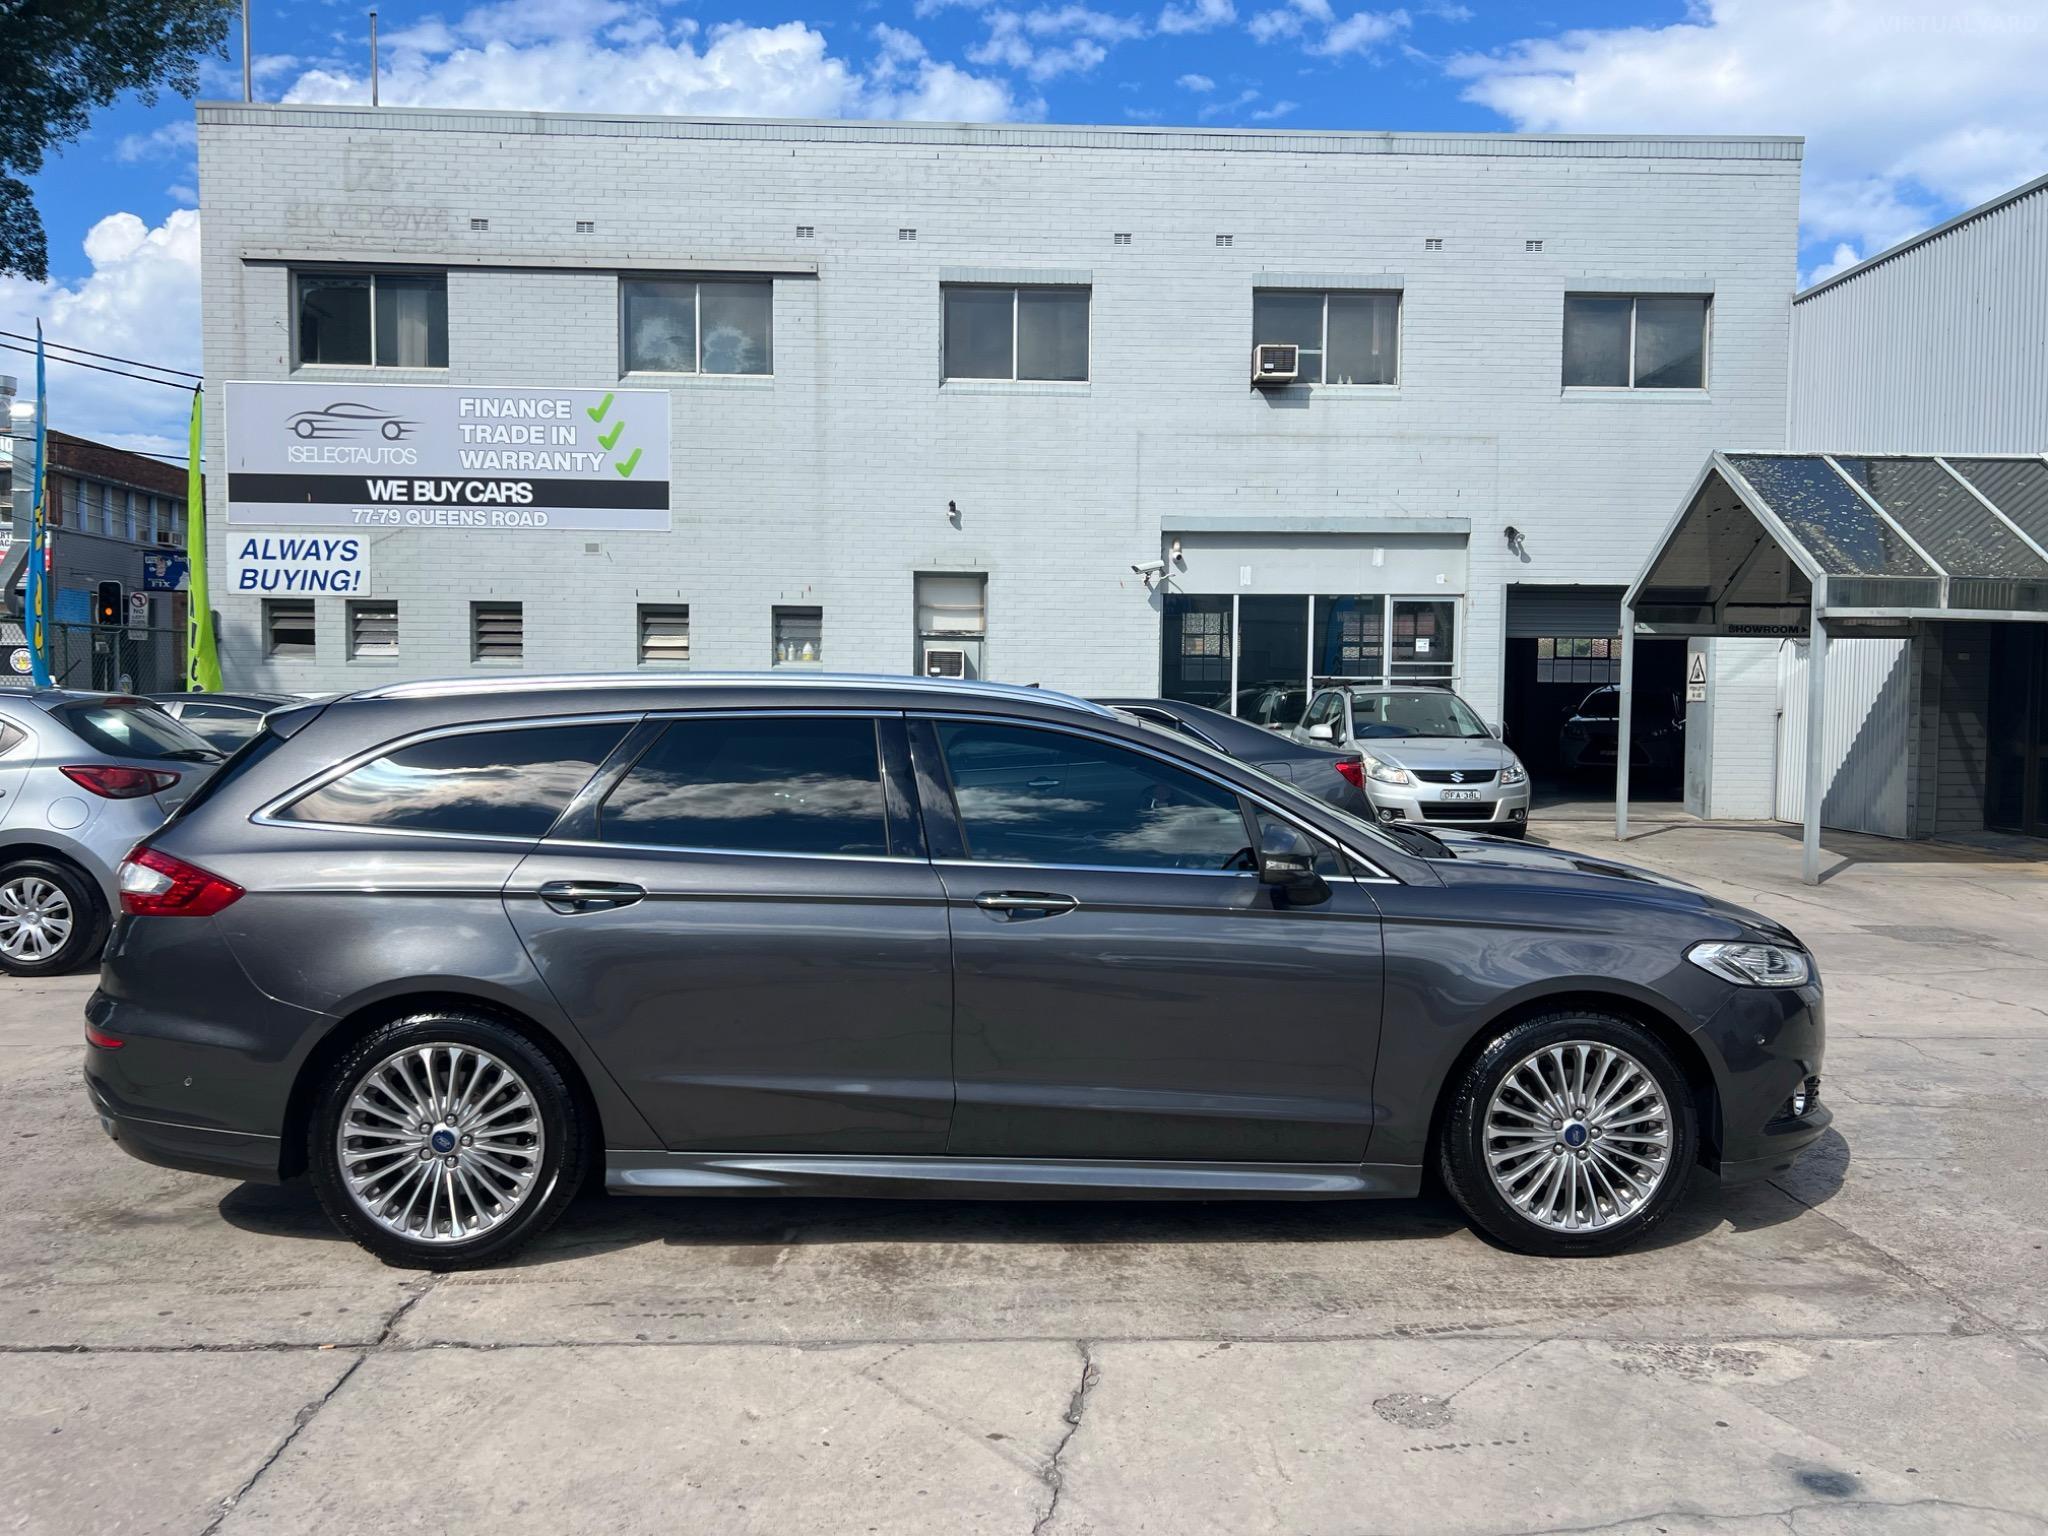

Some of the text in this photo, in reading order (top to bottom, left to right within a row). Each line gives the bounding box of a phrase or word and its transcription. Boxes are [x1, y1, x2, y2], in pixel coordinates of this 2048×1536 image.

[459, 398, 572, 419] FINANCE
[459, 424, 577, 446] TRADE IN
[459, 450, 605, 472] WARRANTY
[366, 479, 533, 504] WE BUY CARS
[351, 508, 549, 527] 77-79 QUEENS ROAD
[239, 538, 359, 562] ALWAYS
[239, 568, 361, 591] BUYING!
[1728, 624, 1799, 634] SHOWROOM
